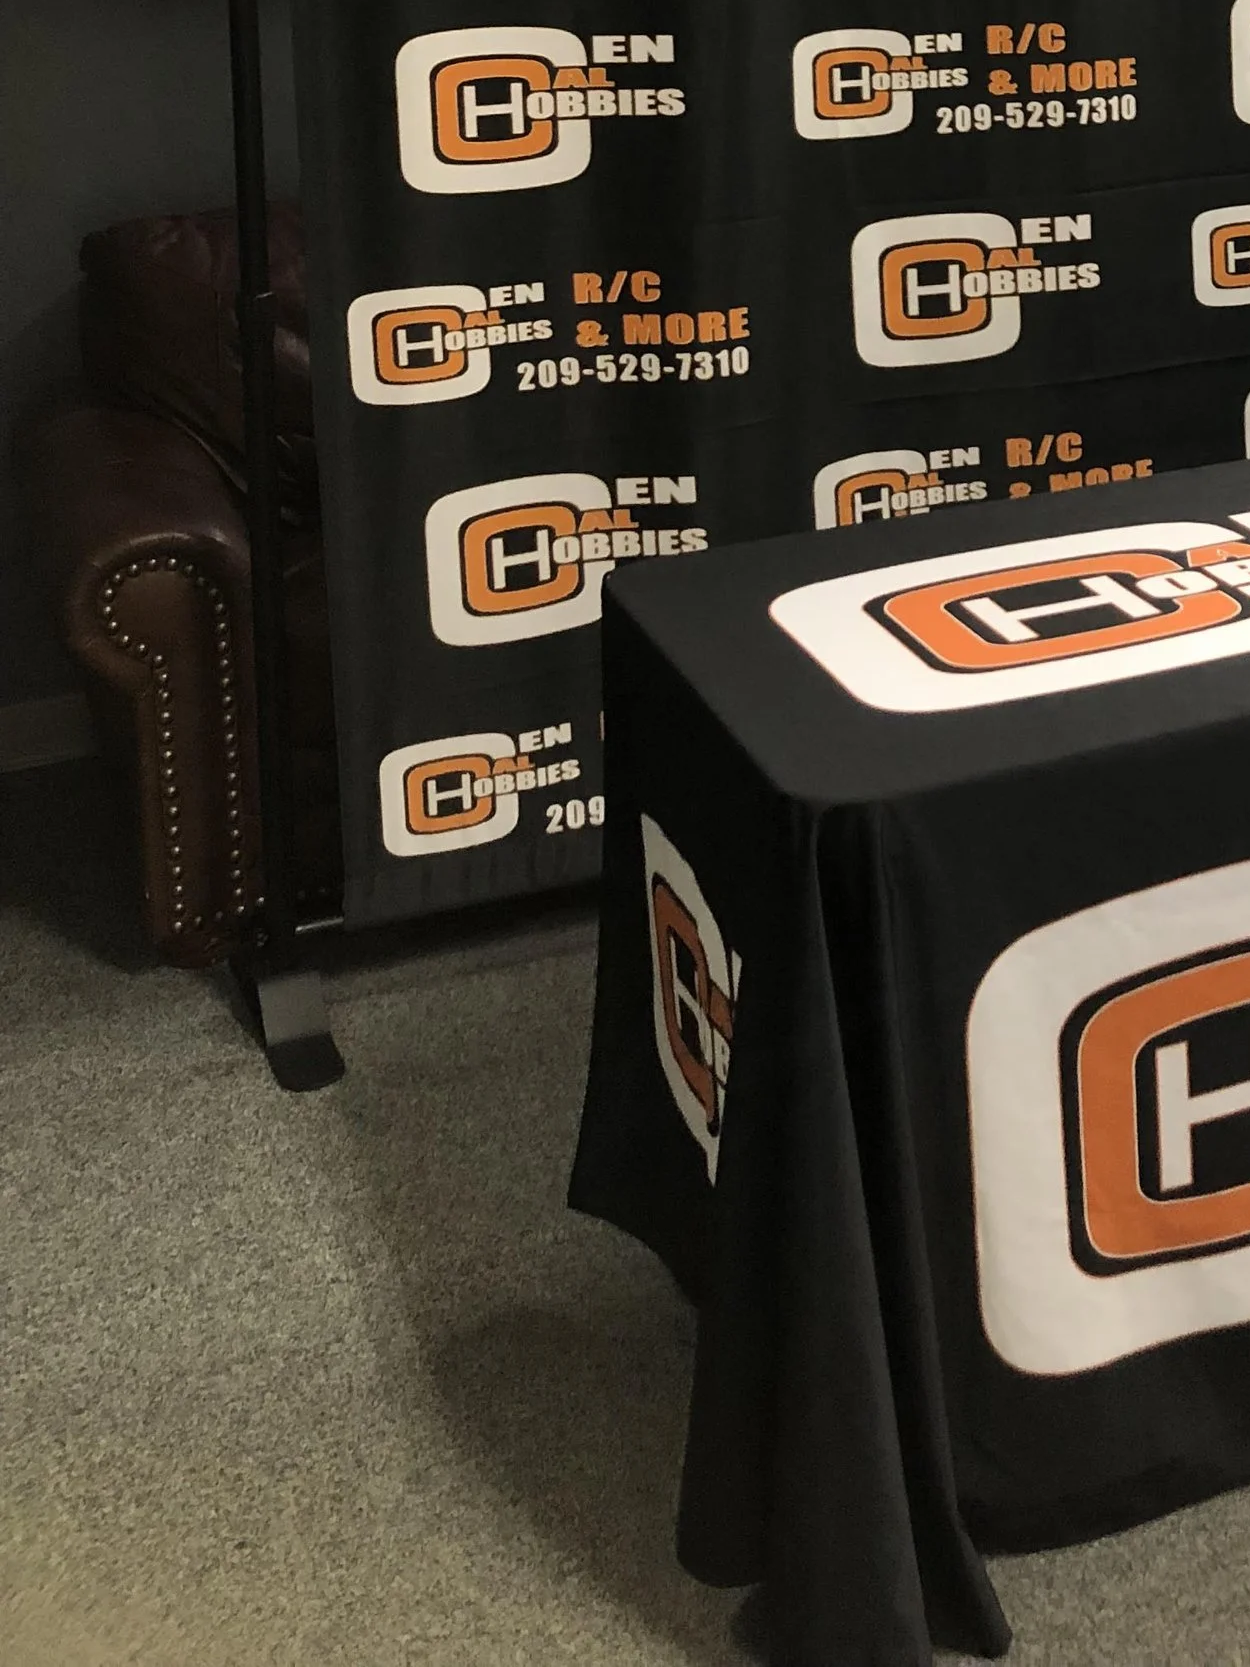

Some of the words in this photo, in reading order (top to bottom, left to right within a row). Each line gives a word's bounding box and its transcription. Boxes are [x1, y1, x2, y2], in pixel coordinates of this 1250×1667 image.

[987, 23, 1064, 54] R/C
[988, 70, 1017, 95] &
[1031, 58, 1134, 93] MORE
[937, 94, 1136, 133] 209-529-7310
[573, 271, 659, 303] R/C
[576, 320, 607, 347] &
[623, 307, 747, 344] MORE
[518, 347, 748, 390] 209-529-7310
[1006, 433, 1080, 467] R/C
